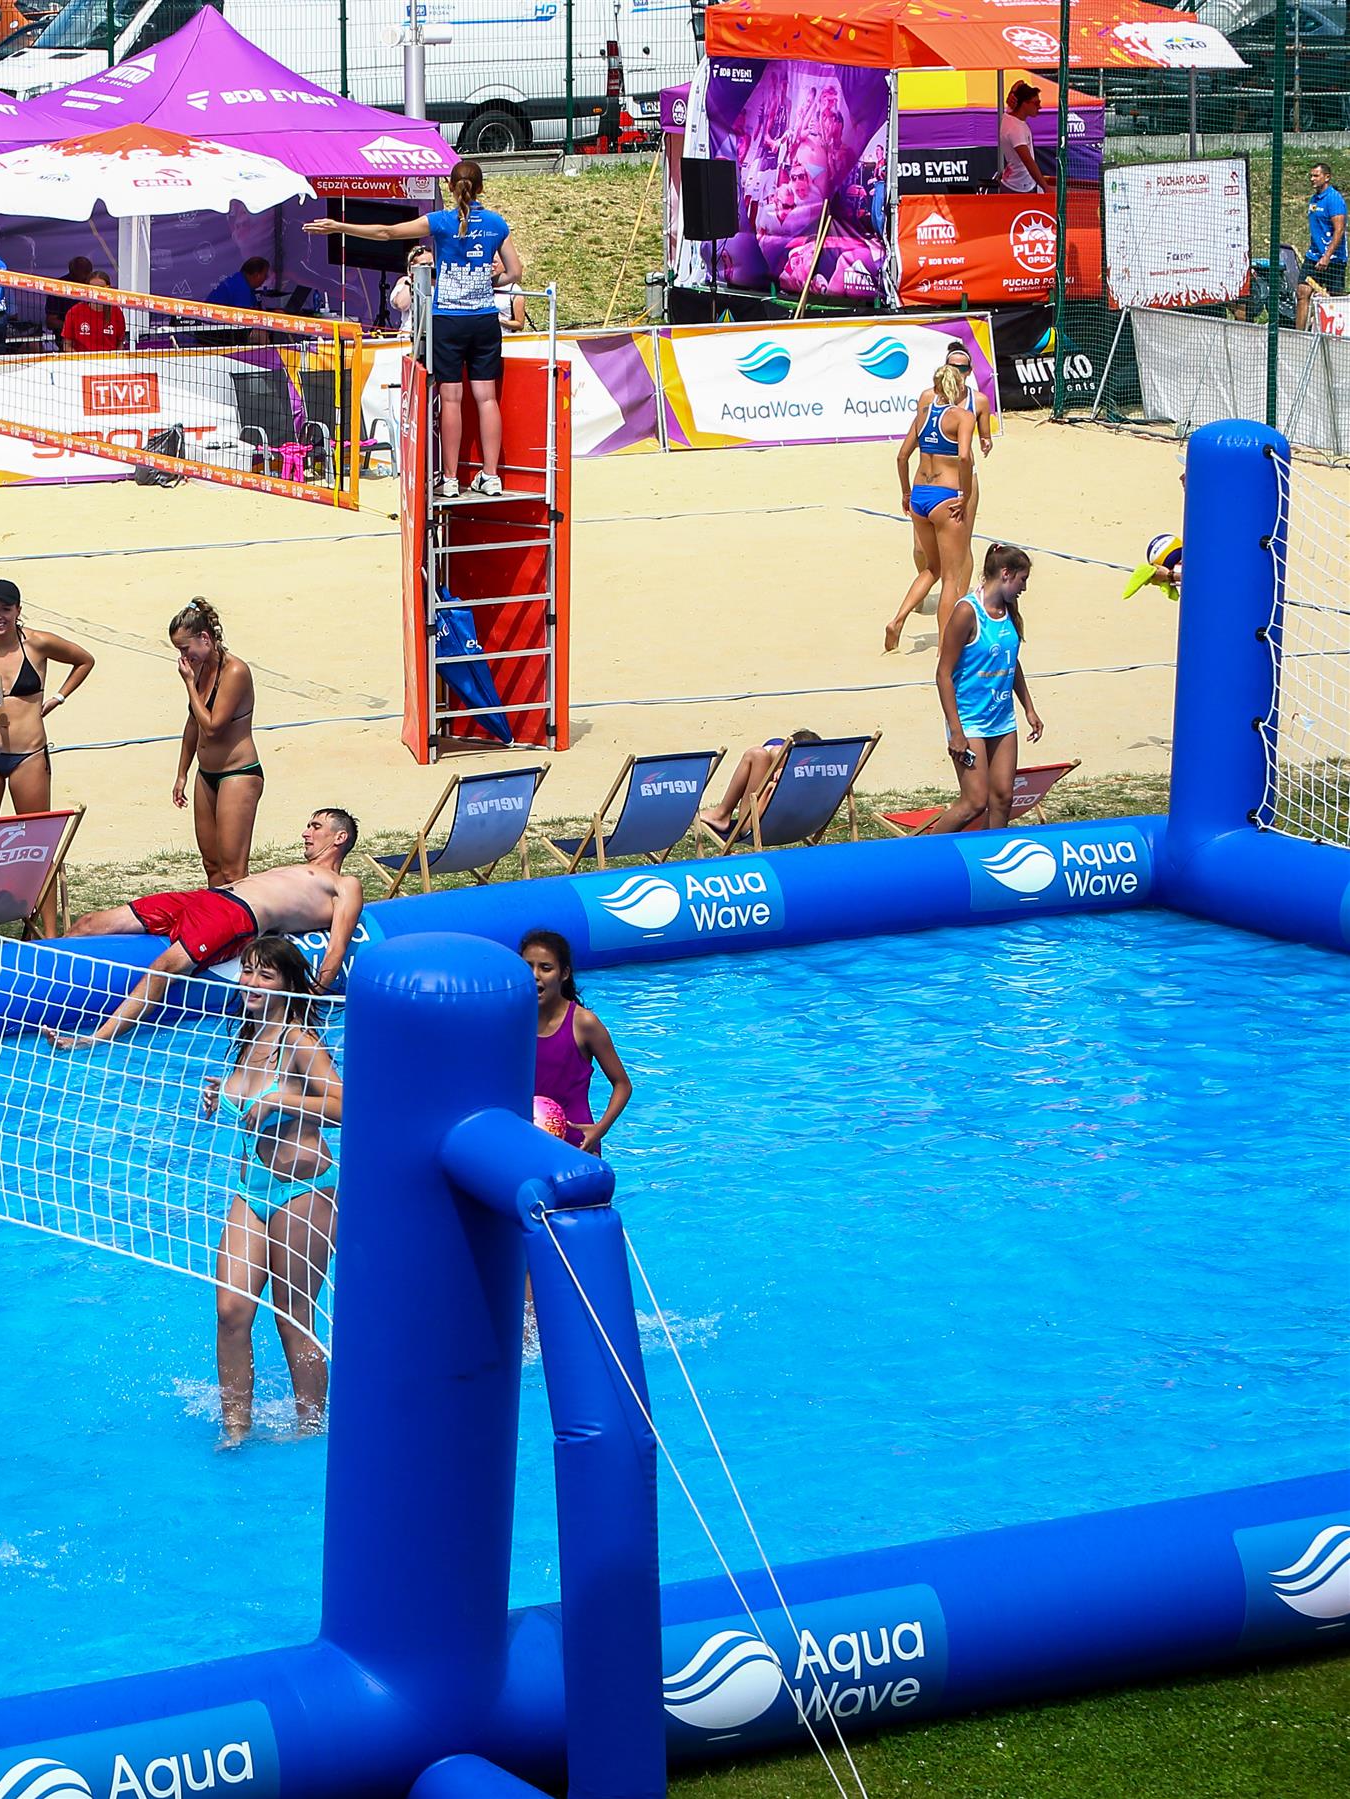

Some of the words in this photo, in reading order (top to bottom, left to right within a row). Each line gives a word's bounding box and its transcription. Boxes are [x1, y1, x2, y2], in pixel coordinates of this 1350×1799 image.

[534, 4, 558, 15] HD
[220, 88, 268, 105] BDB
[269, 88, 338, 108] EVENT
[360, 148, 444, 165] MITKO
[925, 160, 968, 176] EVENT
[316, 181, 349, 191] SĘDZIA
[351, 180, 392, 190] GŁÓWNY
[1157, 176, 1185, 187] PUCHAR
[1186, 174, 1210, 185] POLSKI
[916, 225, 956, 240] MITKO
[1013, 241, 1056, 258] PLAŻ
[943, 257, 965, 265] EVENT
[1027, 255, 1052, 264] OPEN
[1002, 277, 1041, 287] PUCHAR
[95, 382, 146, 403] TVP
[1022, 384, 1043, 396] for
[721, 399, 825, 422] AquaWave
[843, 397, 919, 418] AquaWa
[1004, 649, 1011, 665] 1
[1062, 839, 1137, 872] Aqua
[685, 869, 767, 901] Aqua
[1065, 870, 1139, 898] Wave
[688, 900, 771, 933] Wave
[792, 1618, 926, 1684] Aqua
[792, 1670, 922, 1724] Wave
[105, 1740, 254, 1799] Aqua
